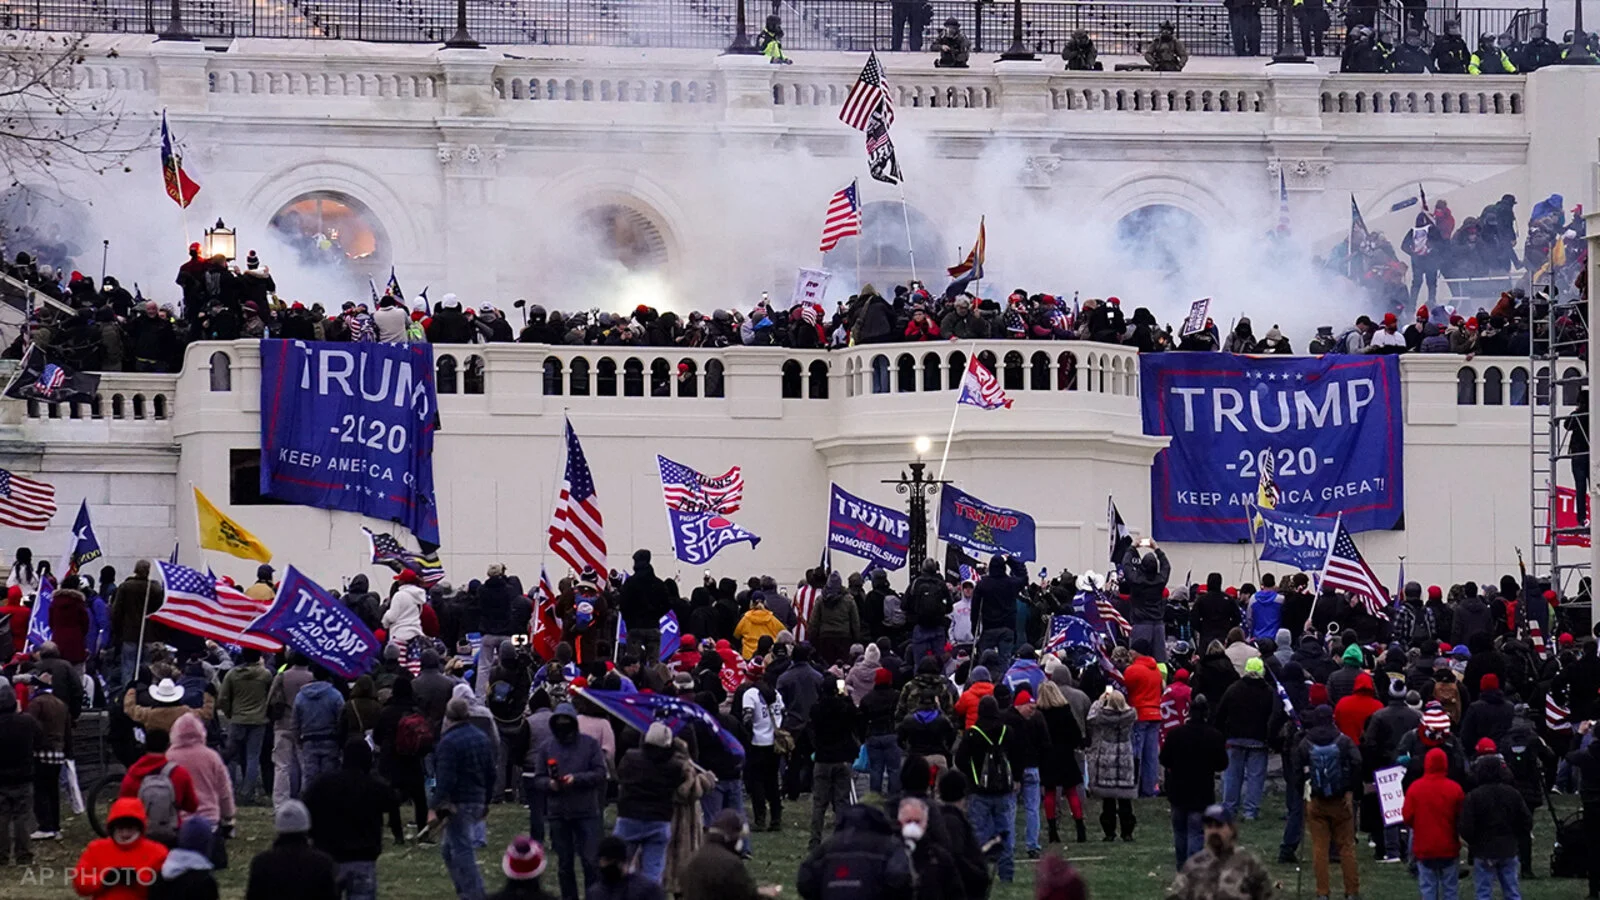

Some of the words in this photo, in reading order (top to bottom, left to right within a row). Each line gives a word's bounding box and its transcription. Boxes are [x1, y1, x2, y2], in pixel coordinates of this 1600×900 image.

[294, 340, 428, 421] TRUM
[1170, 378, 1376, 434] TRUMP
[278, 447, 322, 468] KEEP
[1177, 490, 1222, 506] KEEP
[1228, 489, 1315, 506] AMICA
[835, 493, 910, 538] TRUMP
[954, 501, 1018, 531] TRUMP
[831, 533, 846, 544] NO
[845, 536, 872, 552] MORE
[294, 588, 368, 656] TRUMP
[1378, 773, 1398, 784] KEEP
